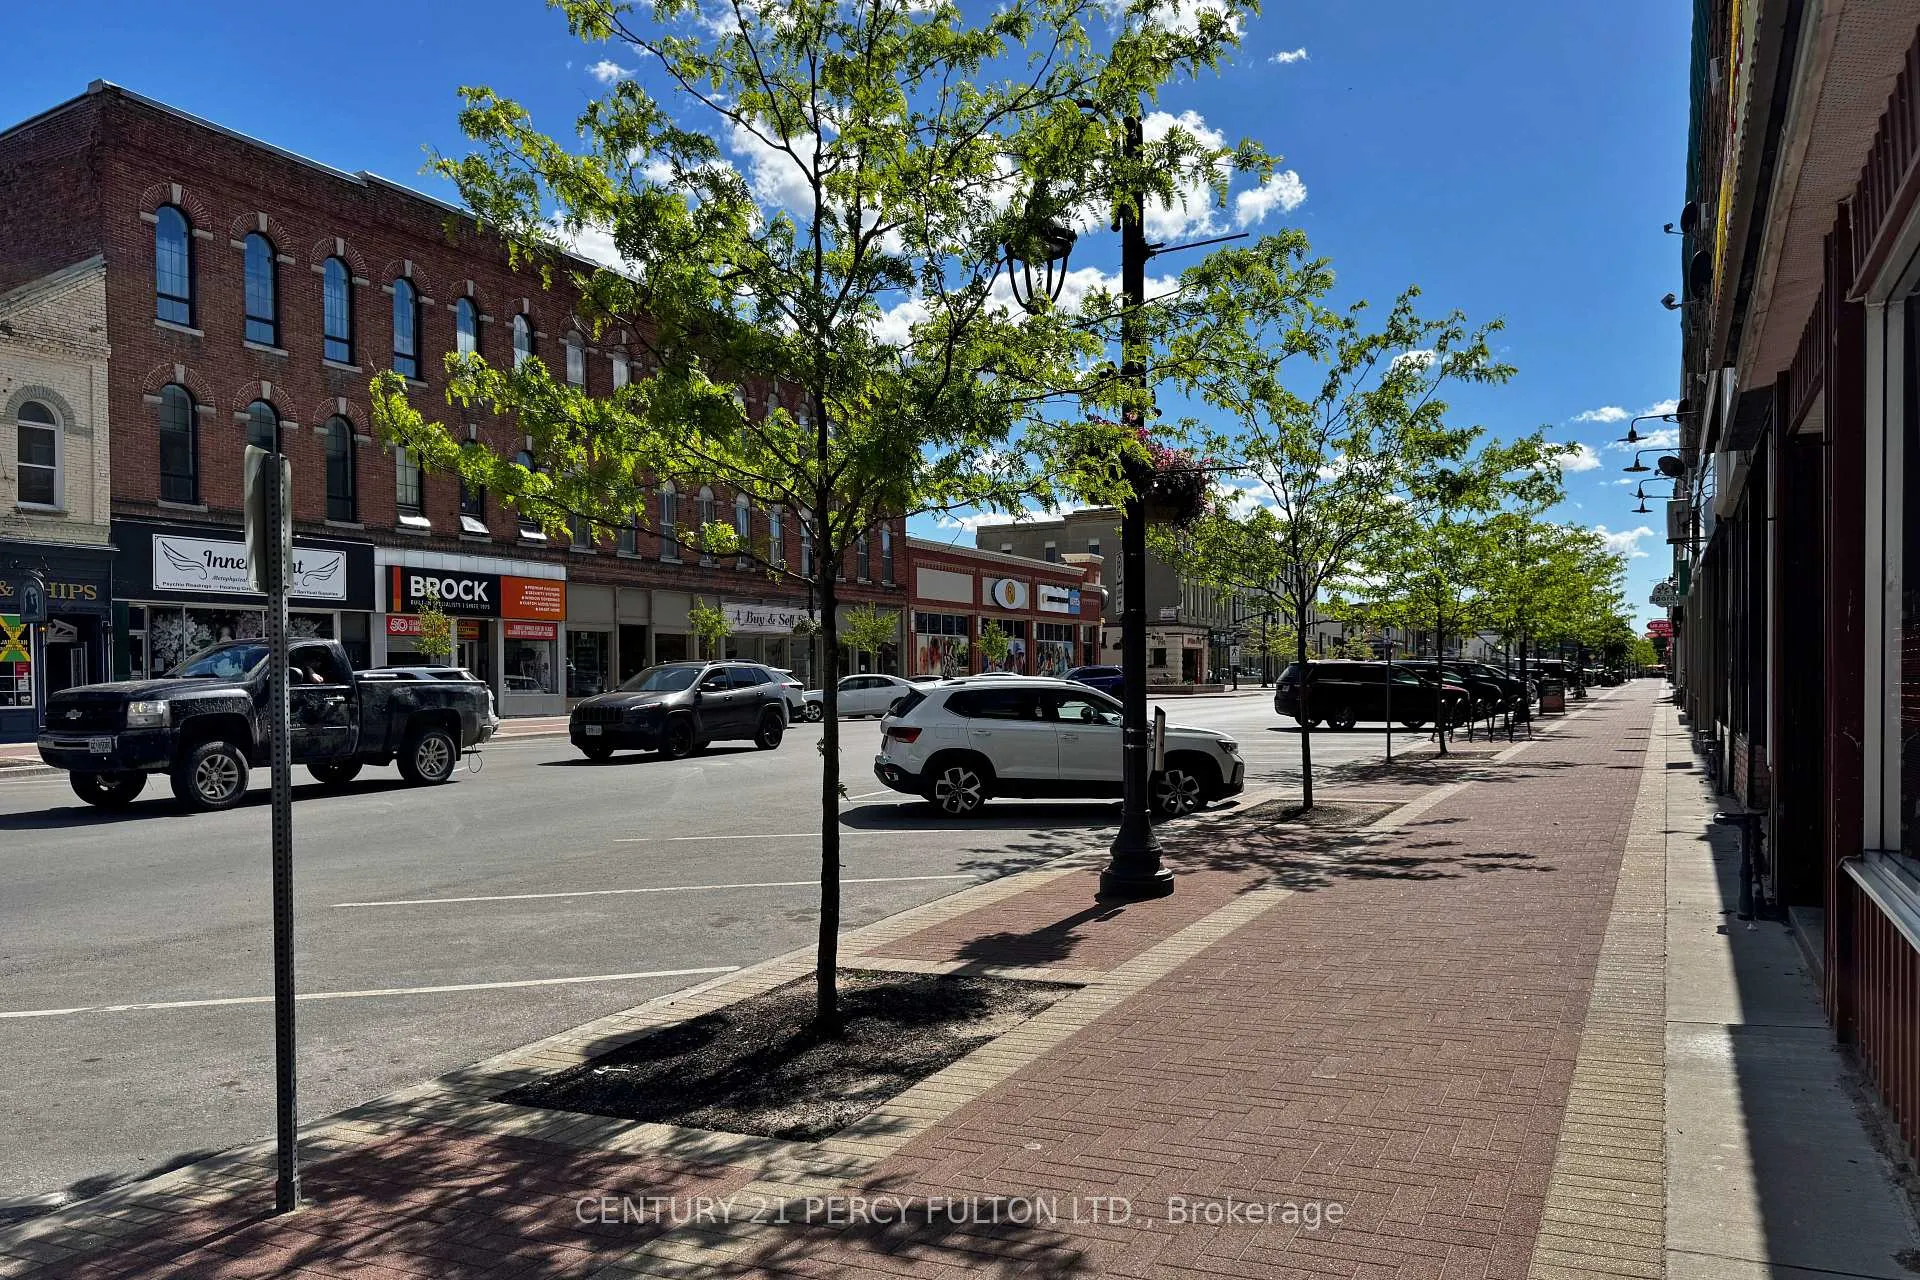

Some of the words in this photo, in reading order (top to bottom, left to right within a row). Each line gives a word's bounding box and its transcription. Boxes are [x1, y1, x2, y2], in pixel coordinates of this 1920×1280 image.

[203, 550, 247, 570] Inne
[46, 582, 98, 600] HIPS
[410, 575, 489, 602] BROCK
[390, 618, 408, 631] 50
[746, 610, 765, 626] Buy
[768, 613, 776, 625] &
[778, 613, 795, 628] Sell
